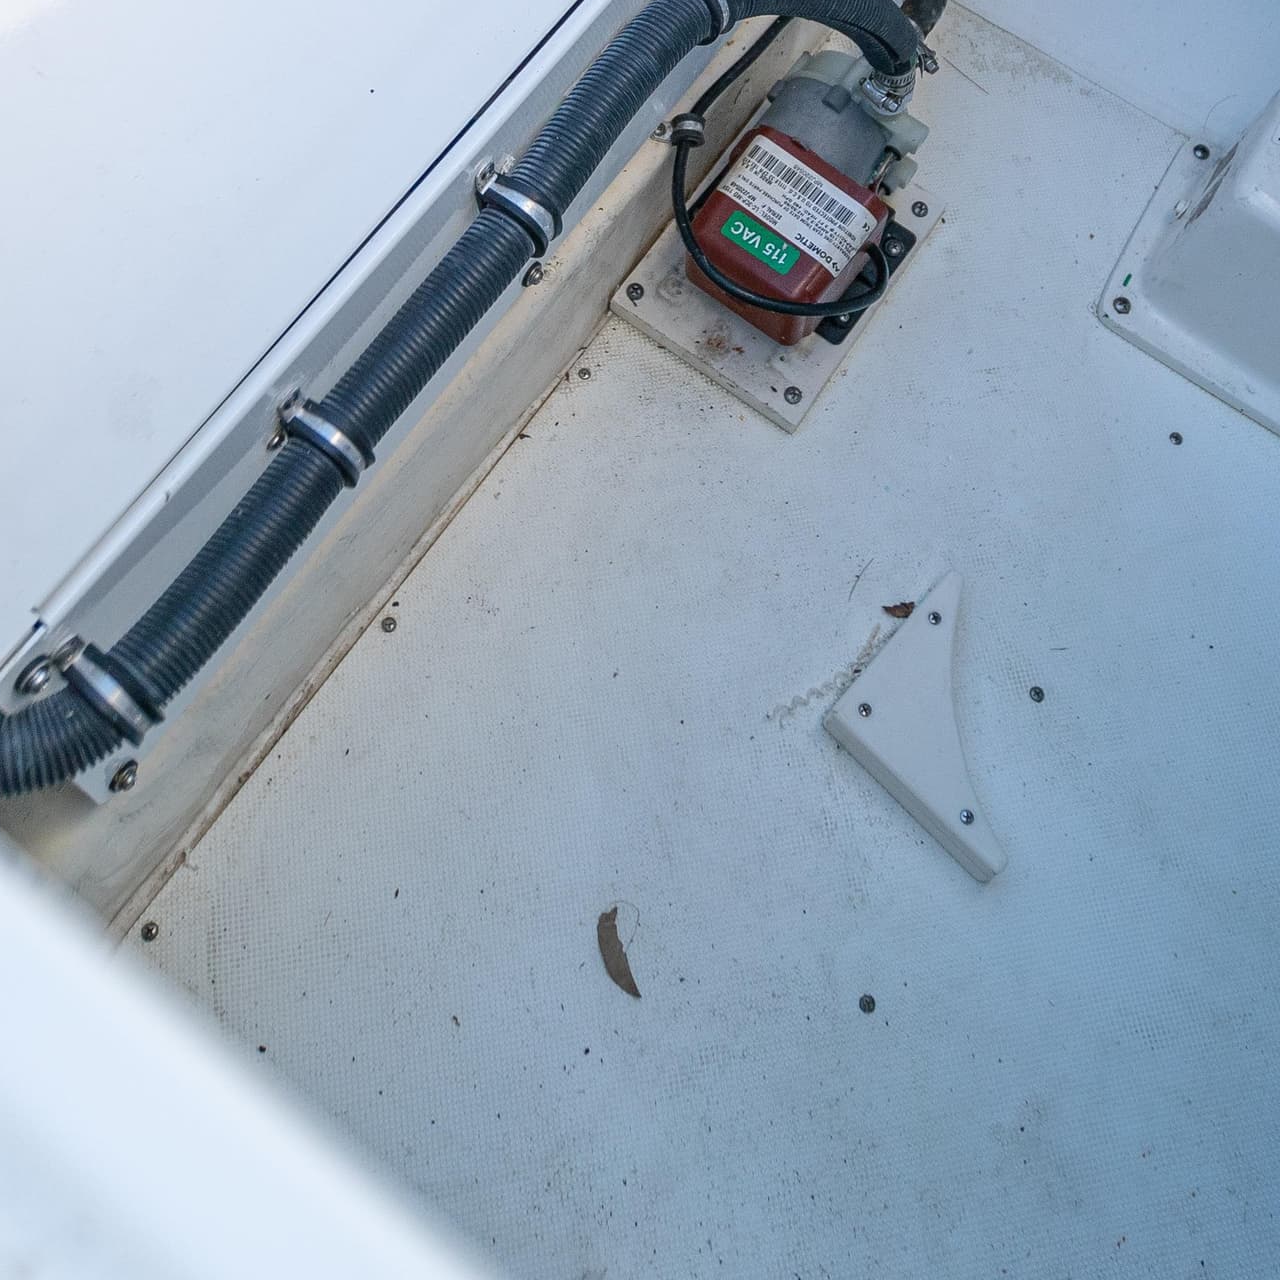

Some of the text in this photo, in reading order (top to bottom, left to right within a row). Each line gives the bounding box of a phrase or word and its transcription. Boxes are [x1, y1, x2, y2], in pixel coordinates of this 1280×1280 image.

[810, 203, 839, 227] PROTECTED
[728, 218, 789, 266] 115 VAC
[793, 231, 833, 264] DOMETIC
